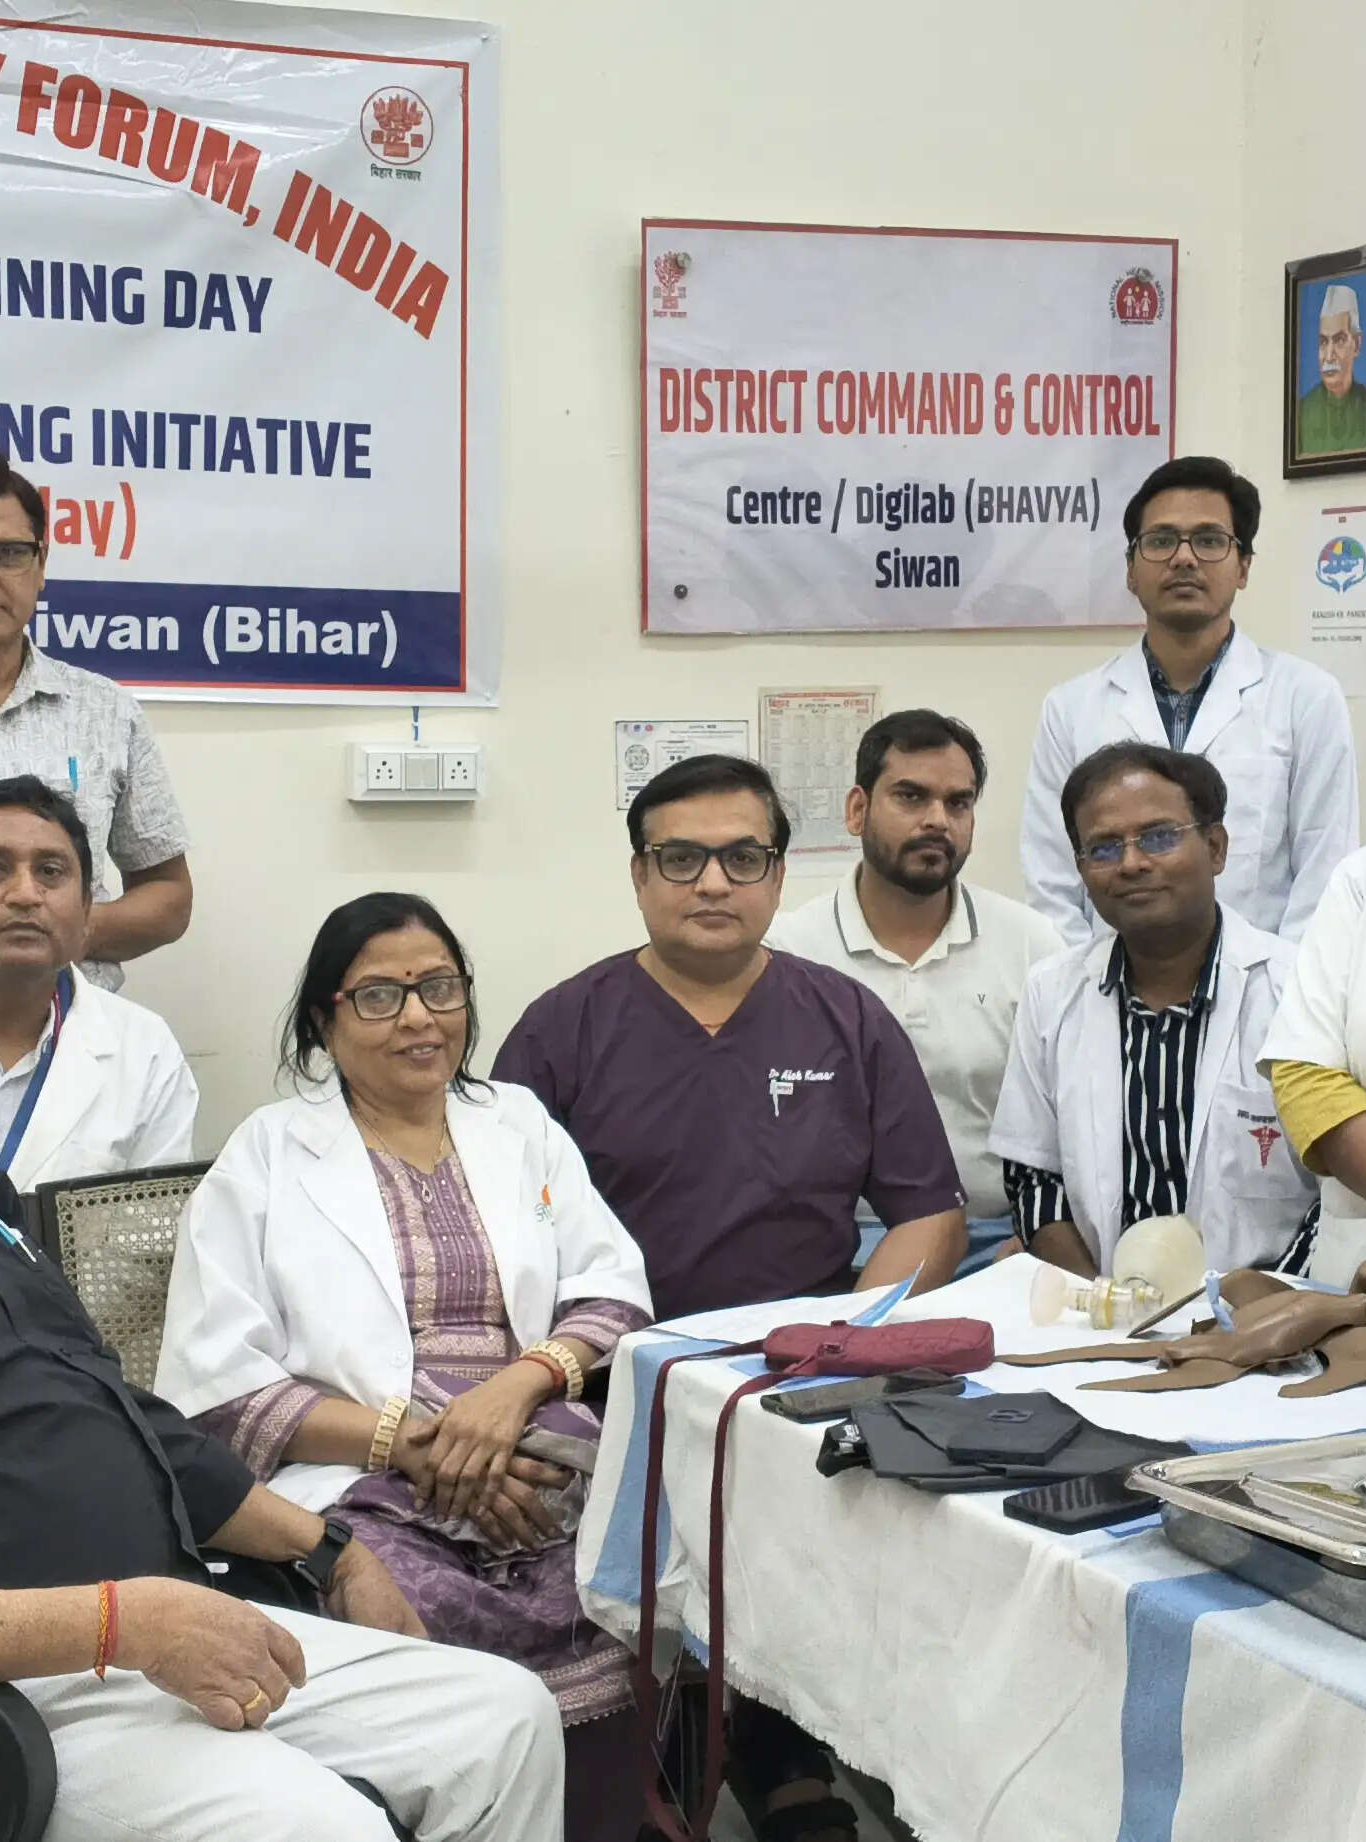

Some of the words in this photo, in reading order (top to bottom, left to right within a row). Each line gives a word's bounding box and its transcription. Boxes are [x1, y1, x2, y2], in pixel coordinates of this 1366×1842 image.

[18, 63, 261, 227] FORUM,
[273, 171, 450, 340] INDIA
[163, 269, 273, 334] DAY
[659, 367, 809, 435] DISTRICT
[816, 369, 985, 437] COMMAND
[994, 373, 1015, 437] &
[1023, 373, 1162, 437] CONTROL
[92, 408, 372, 479] INITIATIVE
[726, 485, 822, 525] Centre
[830, 477, 847, 534] /
[856, 482, 956, 532] Digilab
[965, 477, 1101, 534] (BHAVYA)
[874, 547, 961, 589] Siwan
[35, 600, 179, 651] iwan
[202, 605, 398, 668] (Bihar)
